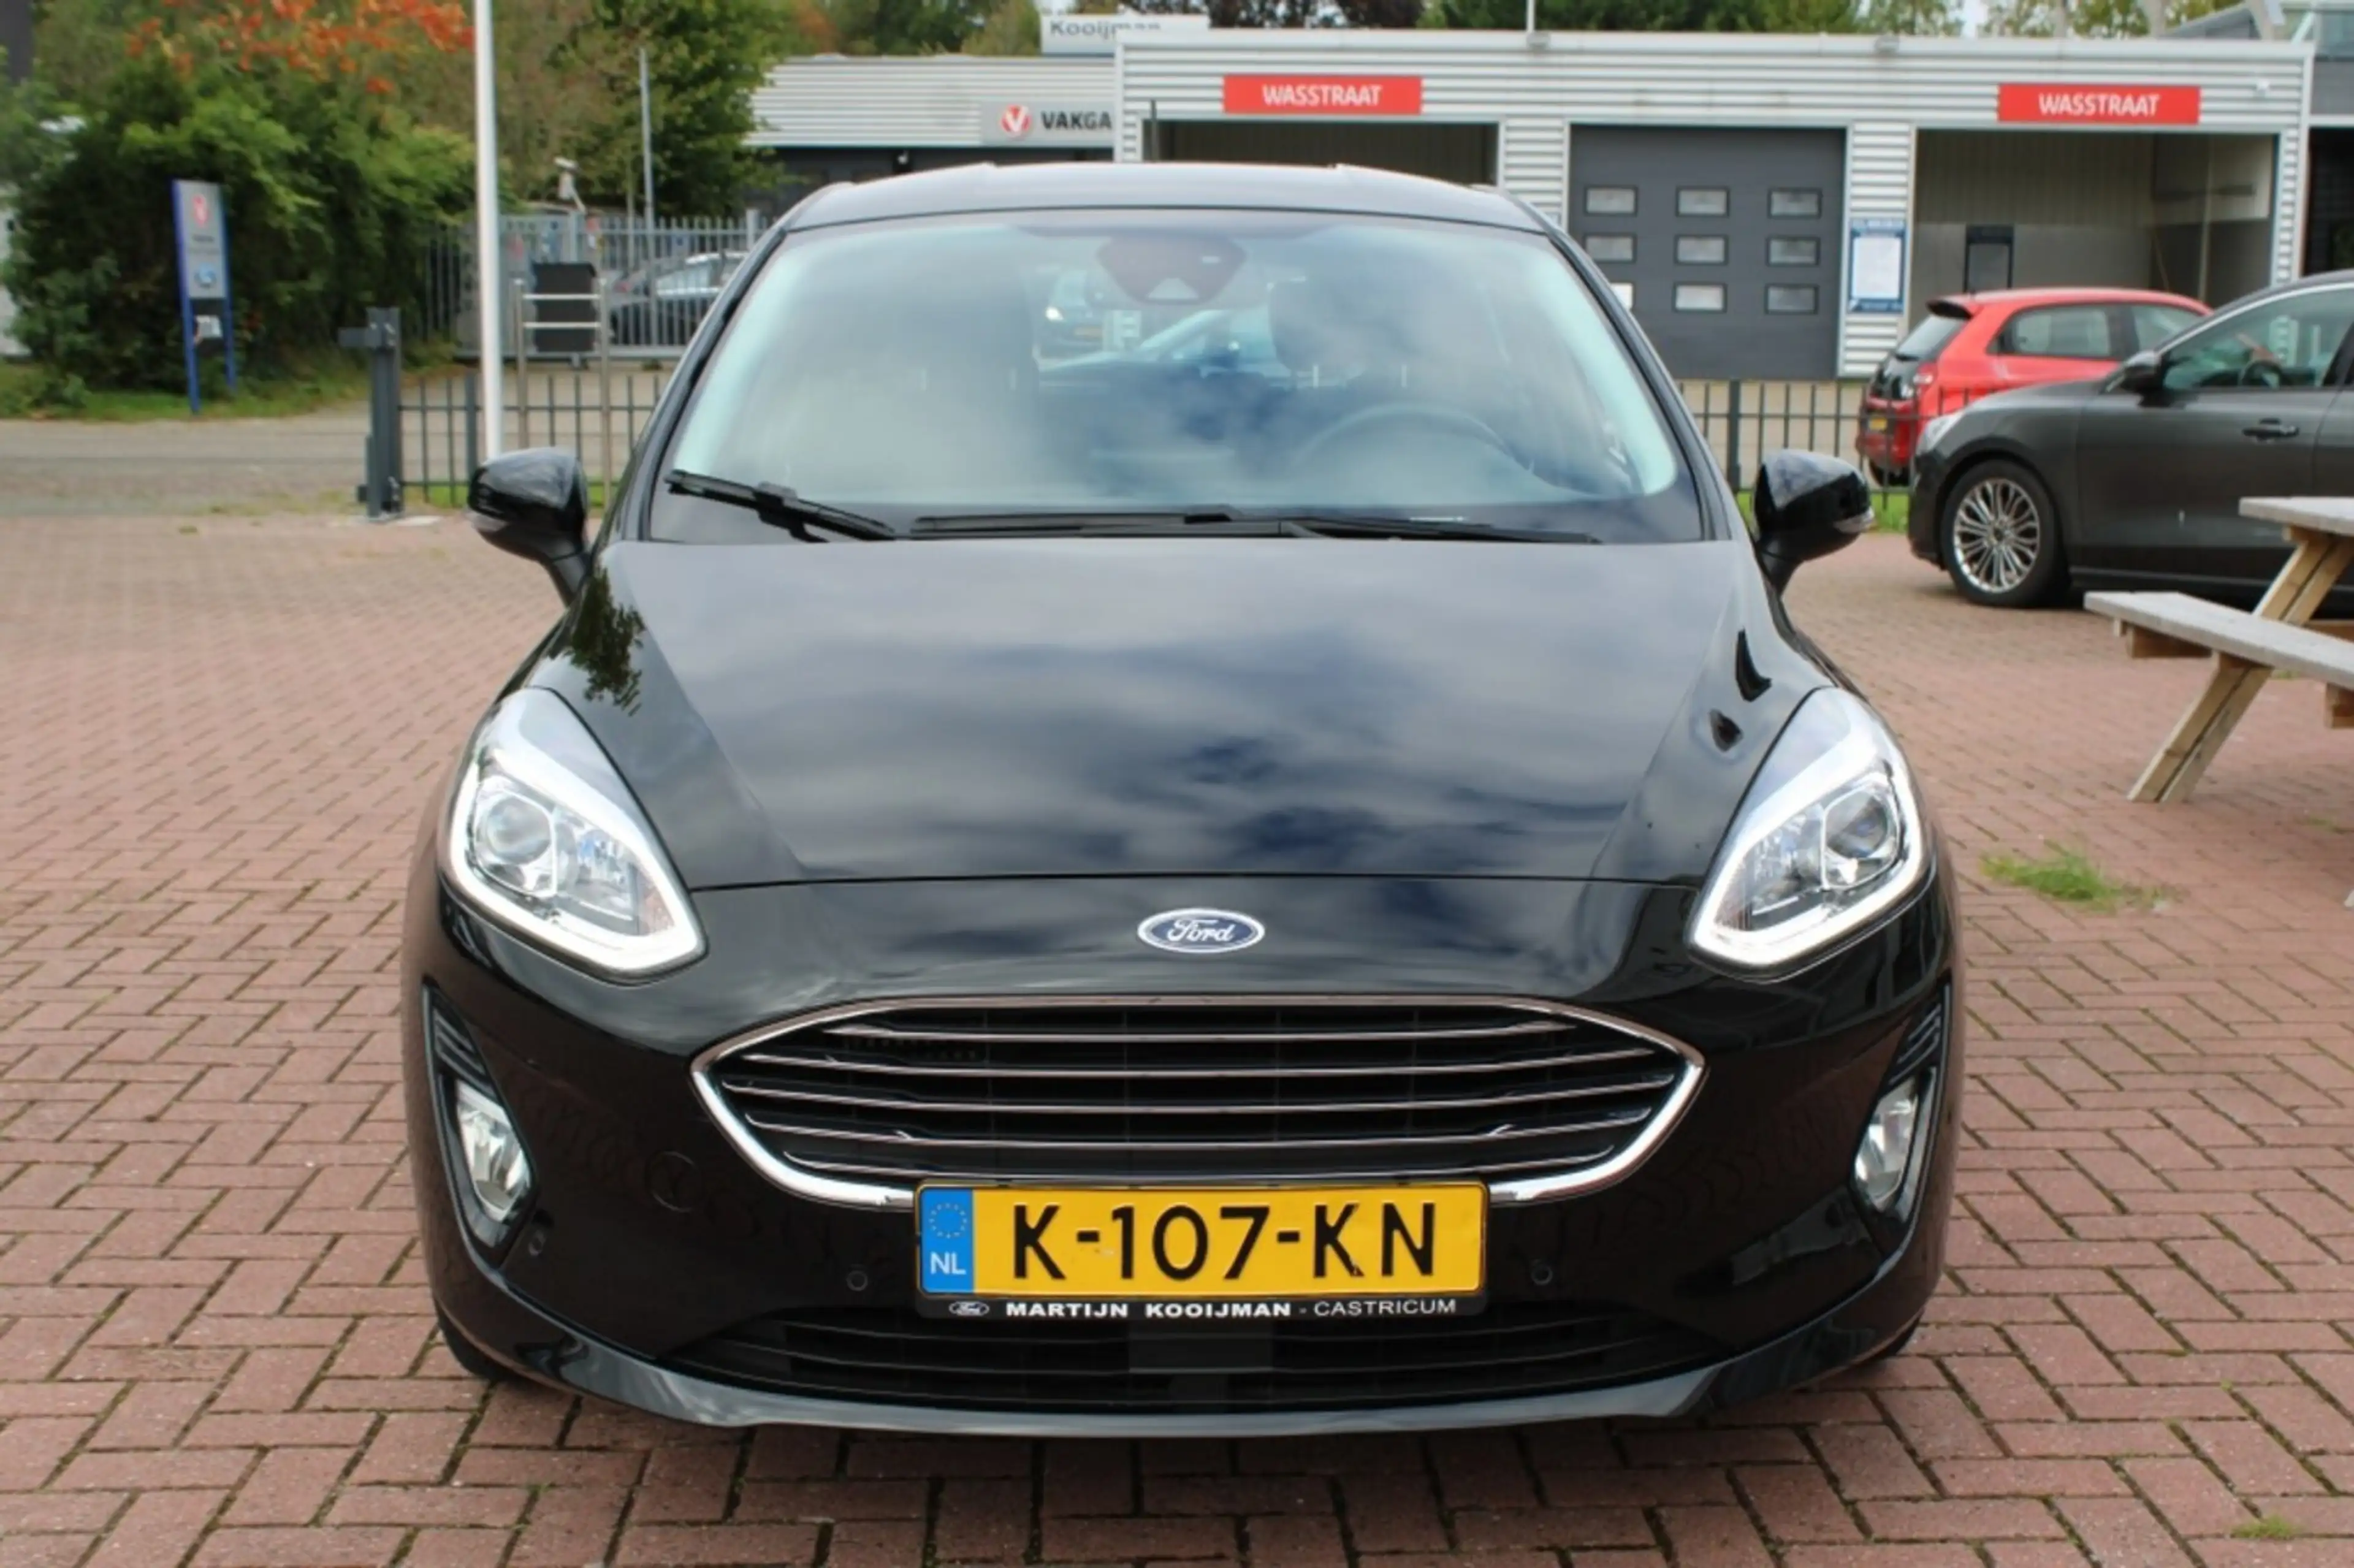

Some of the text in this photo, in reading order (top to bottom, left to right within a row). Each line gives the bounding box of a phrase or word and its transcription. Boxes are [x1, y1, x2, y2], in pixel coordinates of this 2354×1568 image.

[1262, 84, 1382, 107] WASSTRAAT
[2038, 93, 2161, 117] WASSTRAAT
[1041, 111, 1112, 130] VAKGA
[1167, 919, 1236, 942] Ford
[1014, 1203, 1435, 1280] K-107-KN
[931, 1251, 967, 1275] NL
[1006, 1303, 1128, 1317] MARTIJN
[1145, 1302, 1291, 1317] KOOIJMAN
[1313, 1300, 1456, 1316] CASTRICUM
